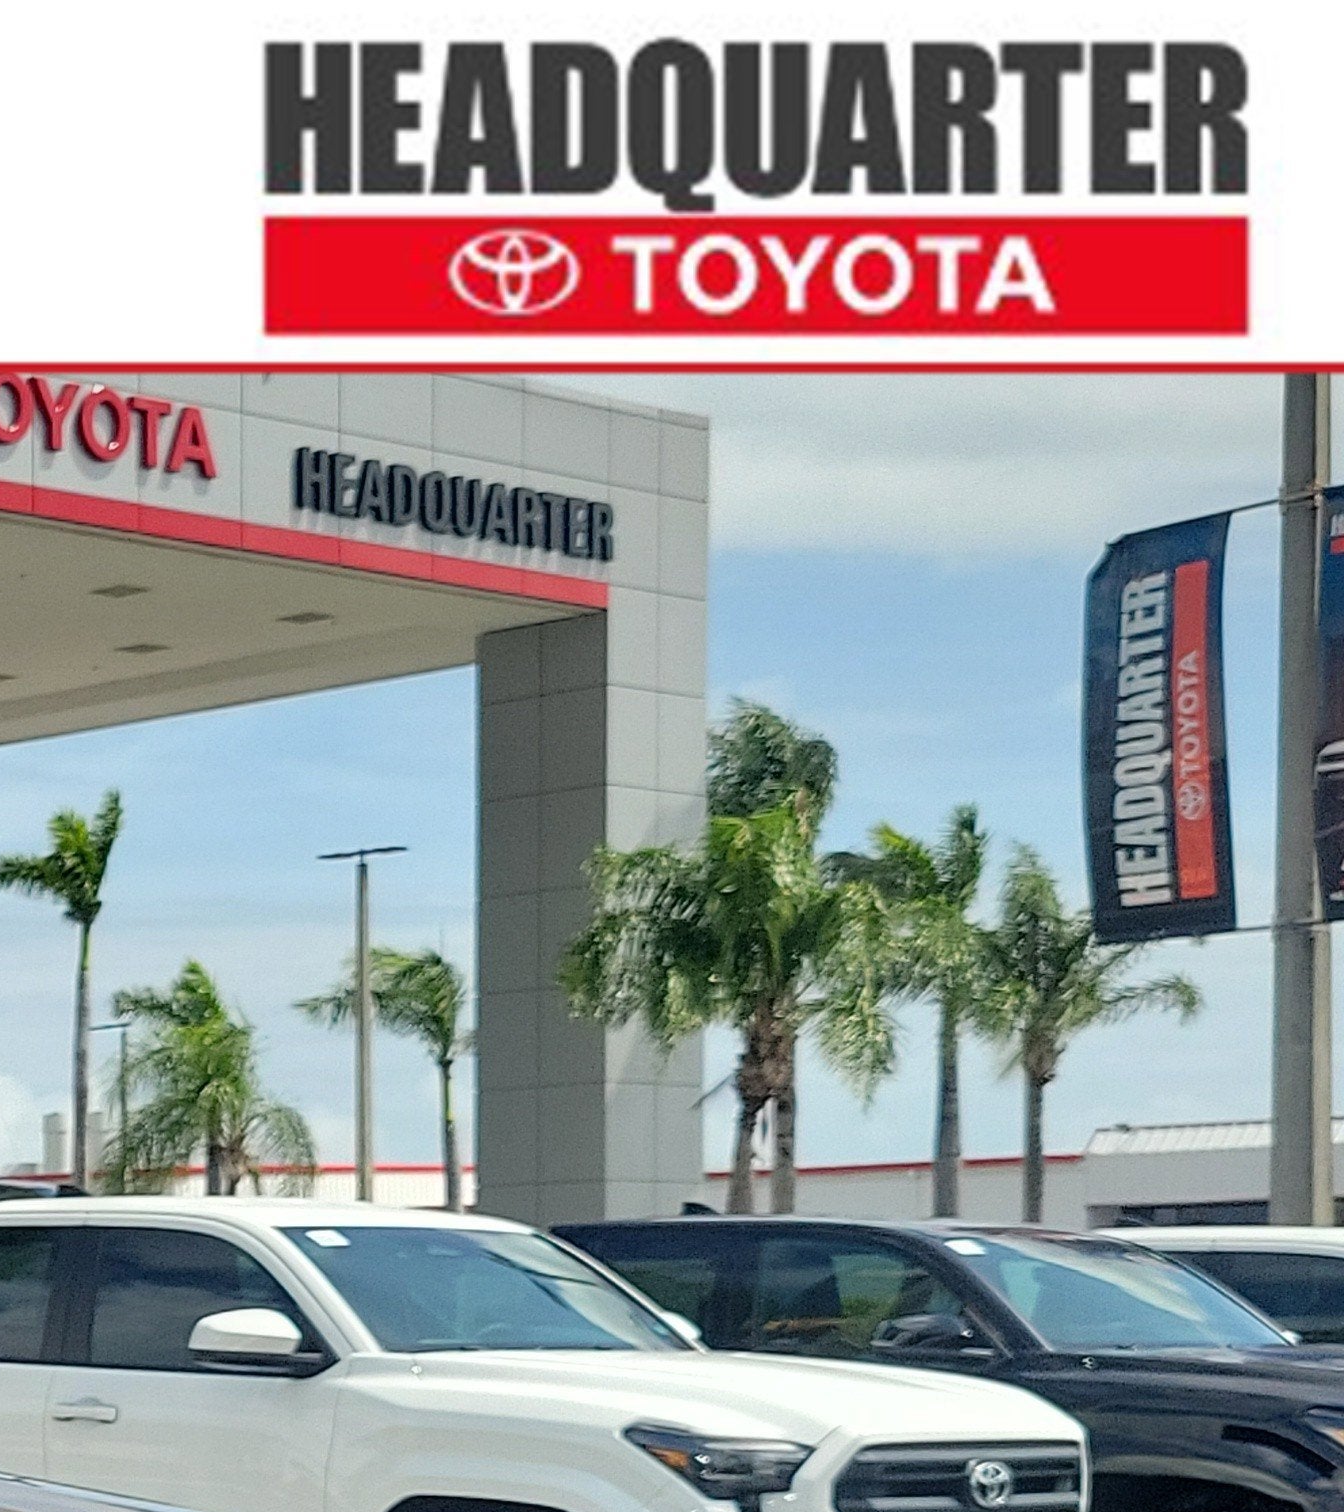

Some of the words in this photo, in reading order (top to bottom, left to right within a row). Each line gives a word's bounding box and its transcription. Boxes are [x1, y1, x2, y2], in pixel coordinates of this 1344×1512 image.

[294, 447, 613, 561] HEADQUARTER
[1114, 571, 1172, 907] HEADQUARTER
[1177, 650, 1201, 779] TOYOTA
